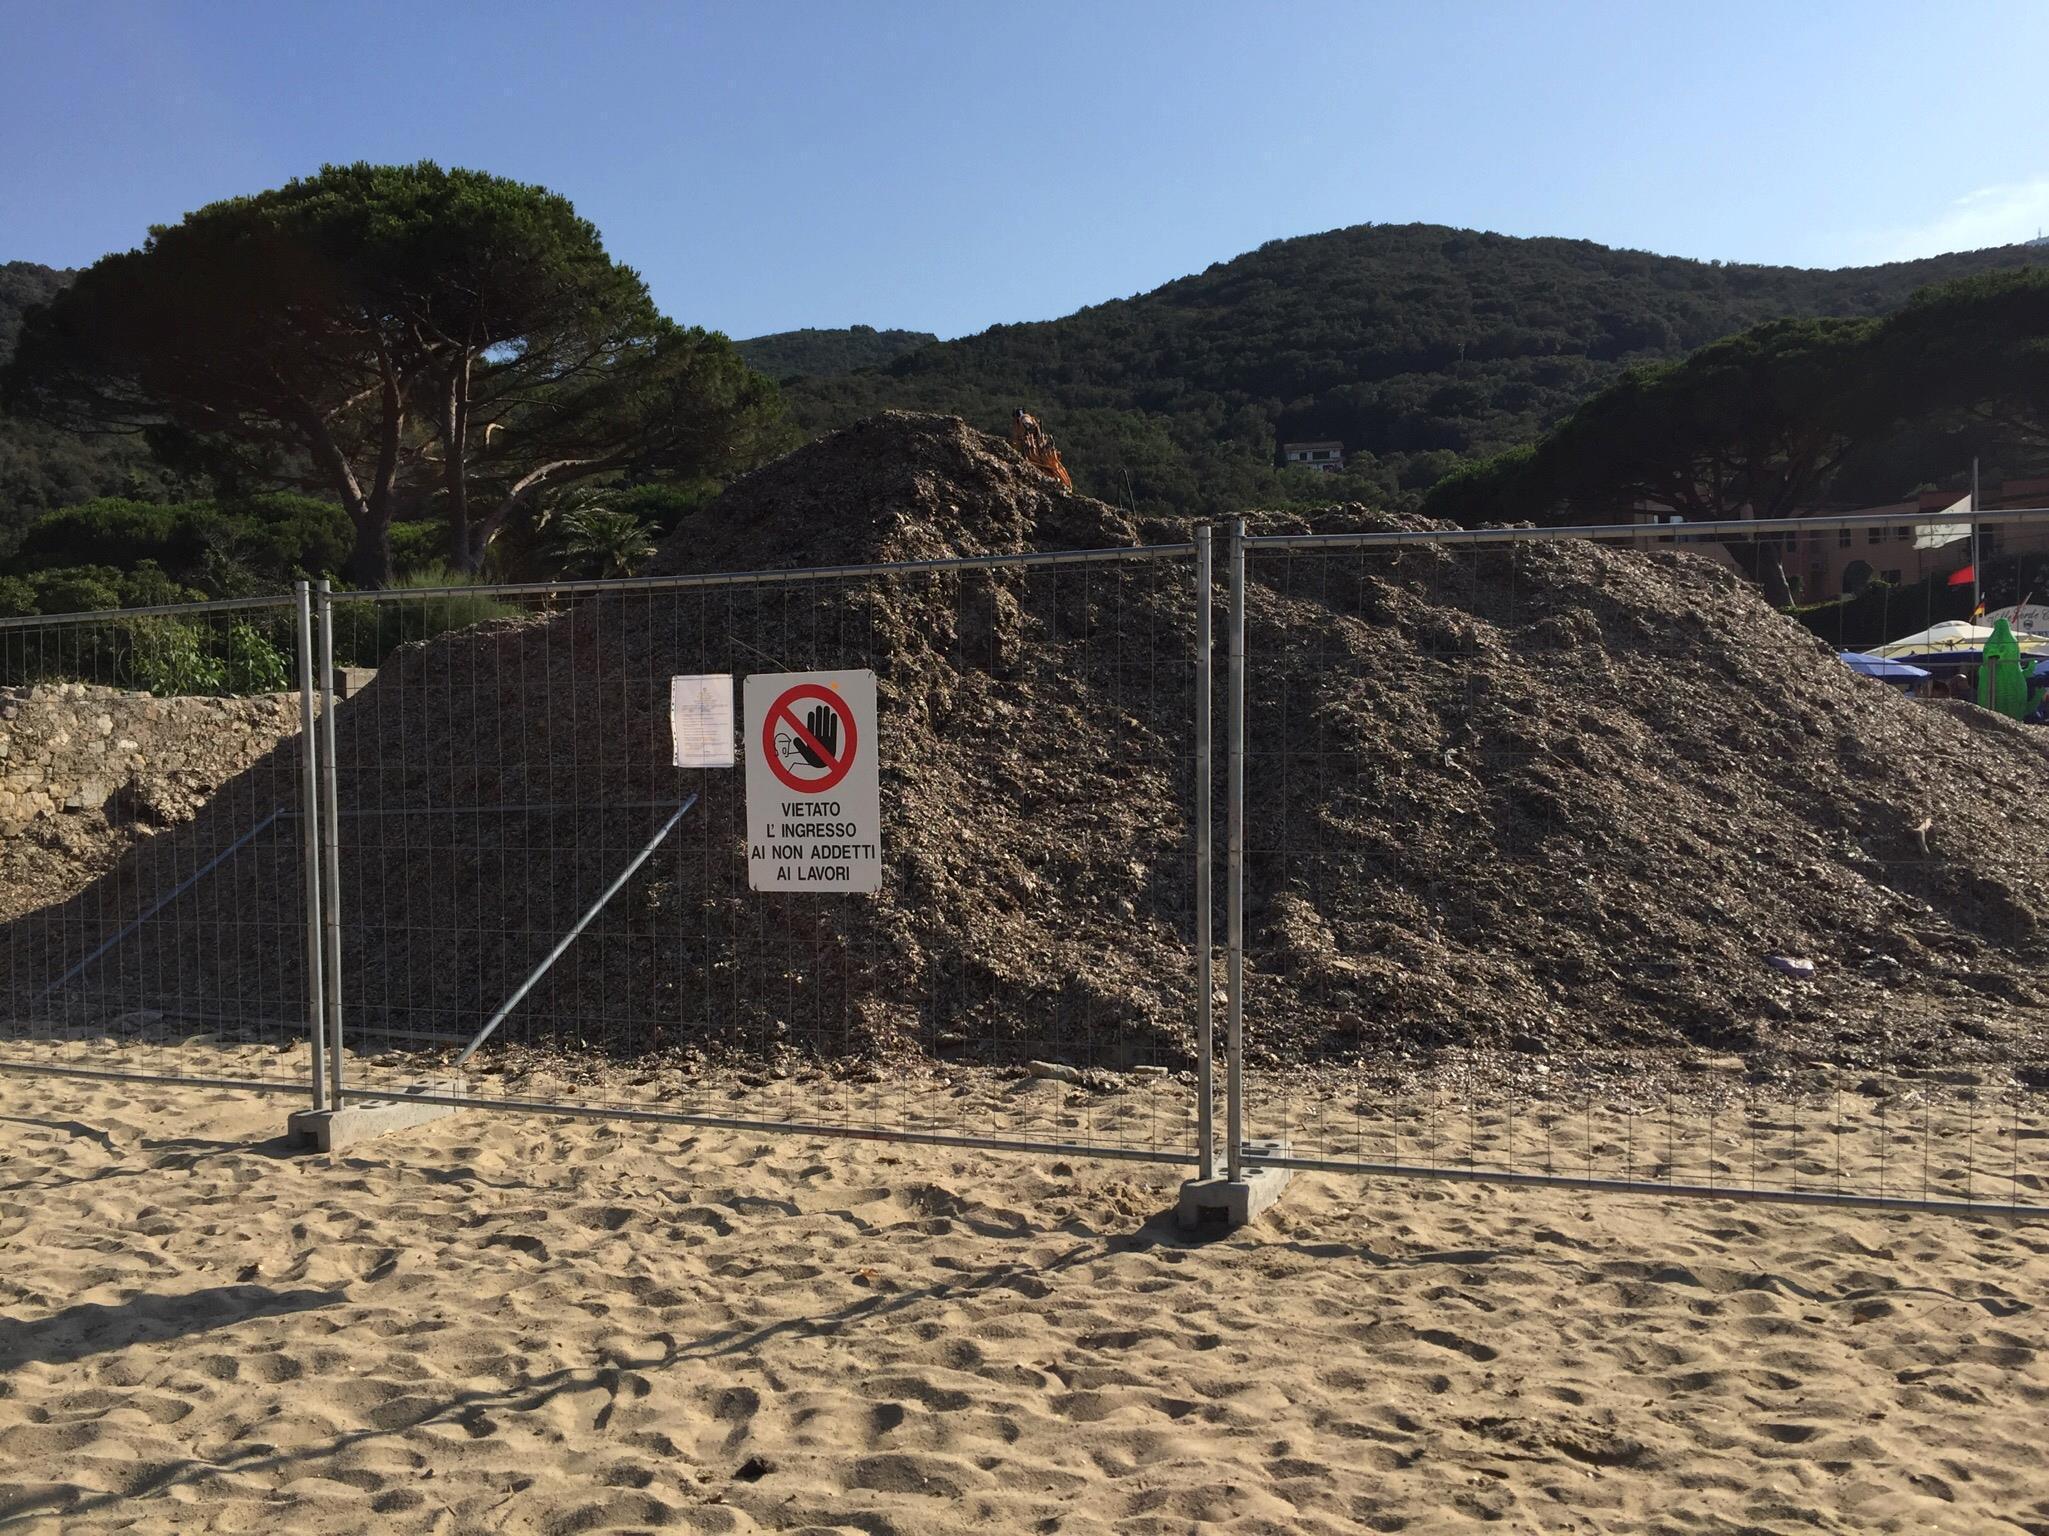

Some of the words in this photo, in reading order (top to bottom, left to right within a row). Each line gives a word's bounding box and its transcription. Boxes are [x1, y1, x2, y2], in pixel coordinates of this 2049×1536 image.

[781, 801, 841, 817] VIETATO
[766, 823, 776, 838] L'
[781, 822, 857, 838] INGRESSO
[751, 845, 765, 859] AI
[772, 844, 803, 860] NON
[810, 844, 875, 859] ADDETTI
[776, 866, 791, 880] AI
[797, 866, 850, 881] LAVORI
